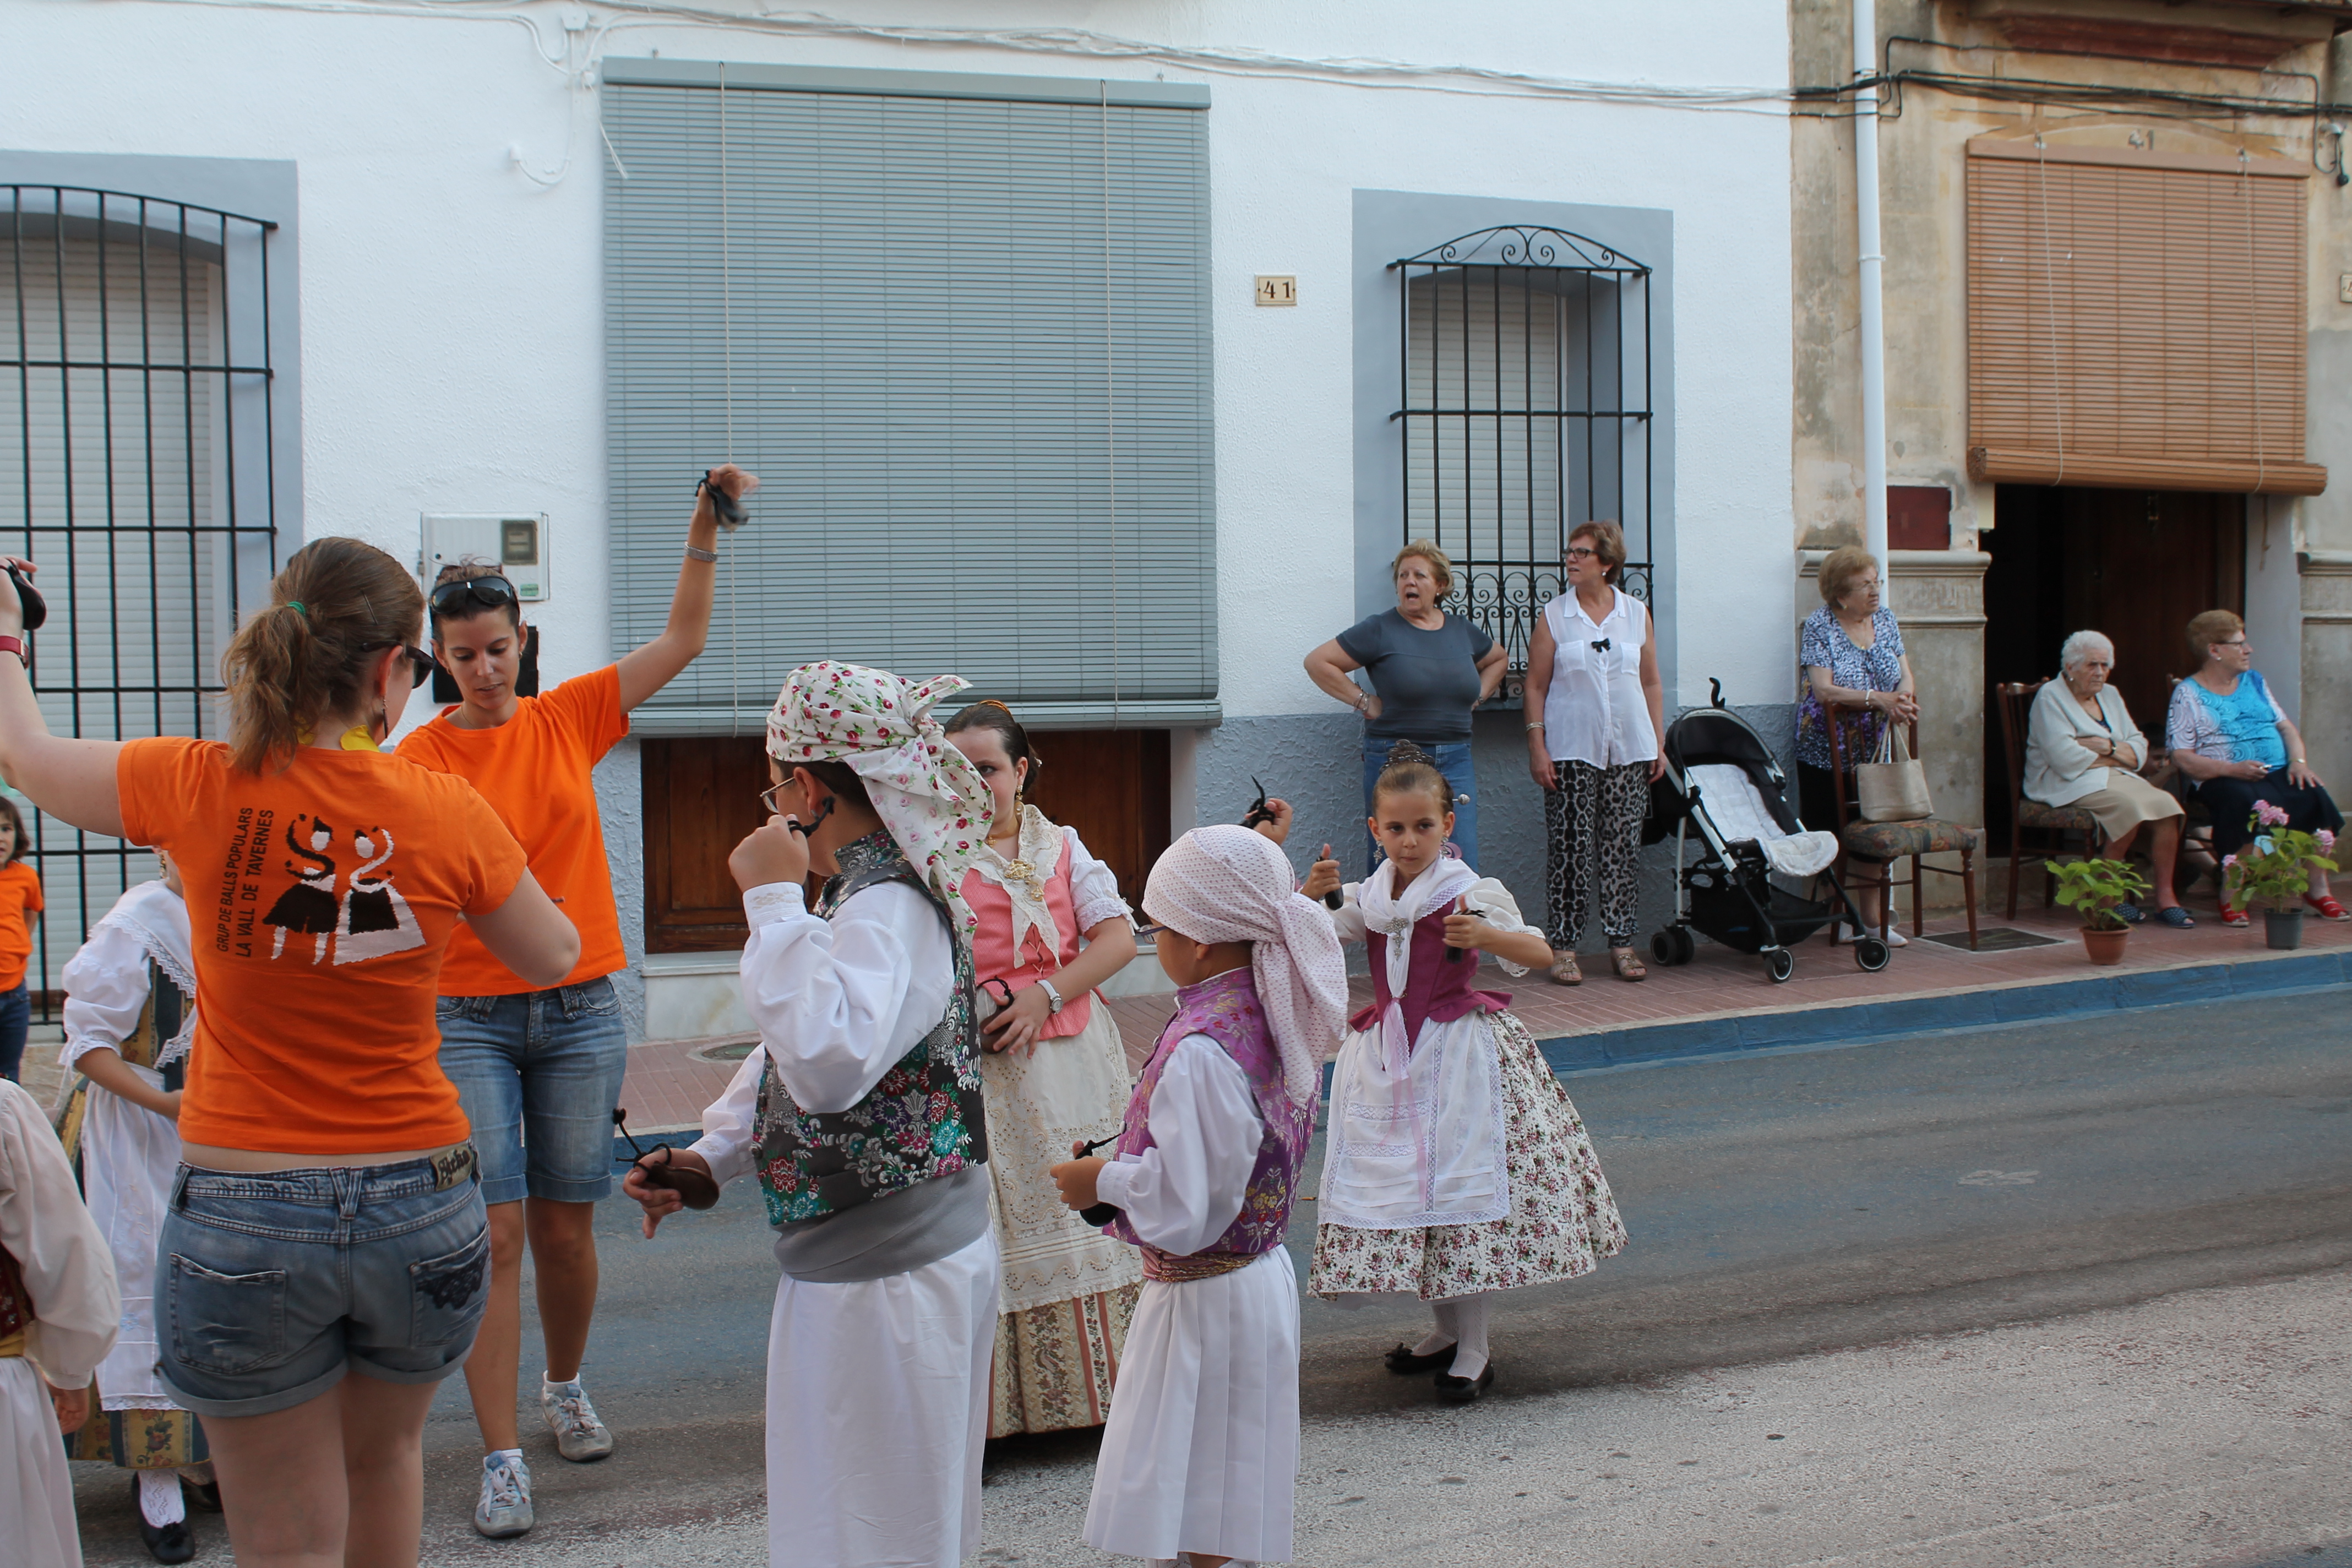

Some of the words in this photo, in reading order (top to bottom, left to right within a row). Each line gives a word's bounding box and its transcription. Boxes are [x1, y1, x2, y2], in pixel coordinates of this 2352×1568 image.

[1262, 280, 1290, 299] 41
[226, 808, 253, 869] POPULARS
[245, 810, 274, 876] TAVERNES
[220, 872, 238, 906] BALLS
[241, 883, 259, 901] DE
[219, 907, 232, 923] DE
[237, 908, 255, 936] VALL
[216, 923, 230, 952] GRUP
[235, 943, 252, 957] LA
